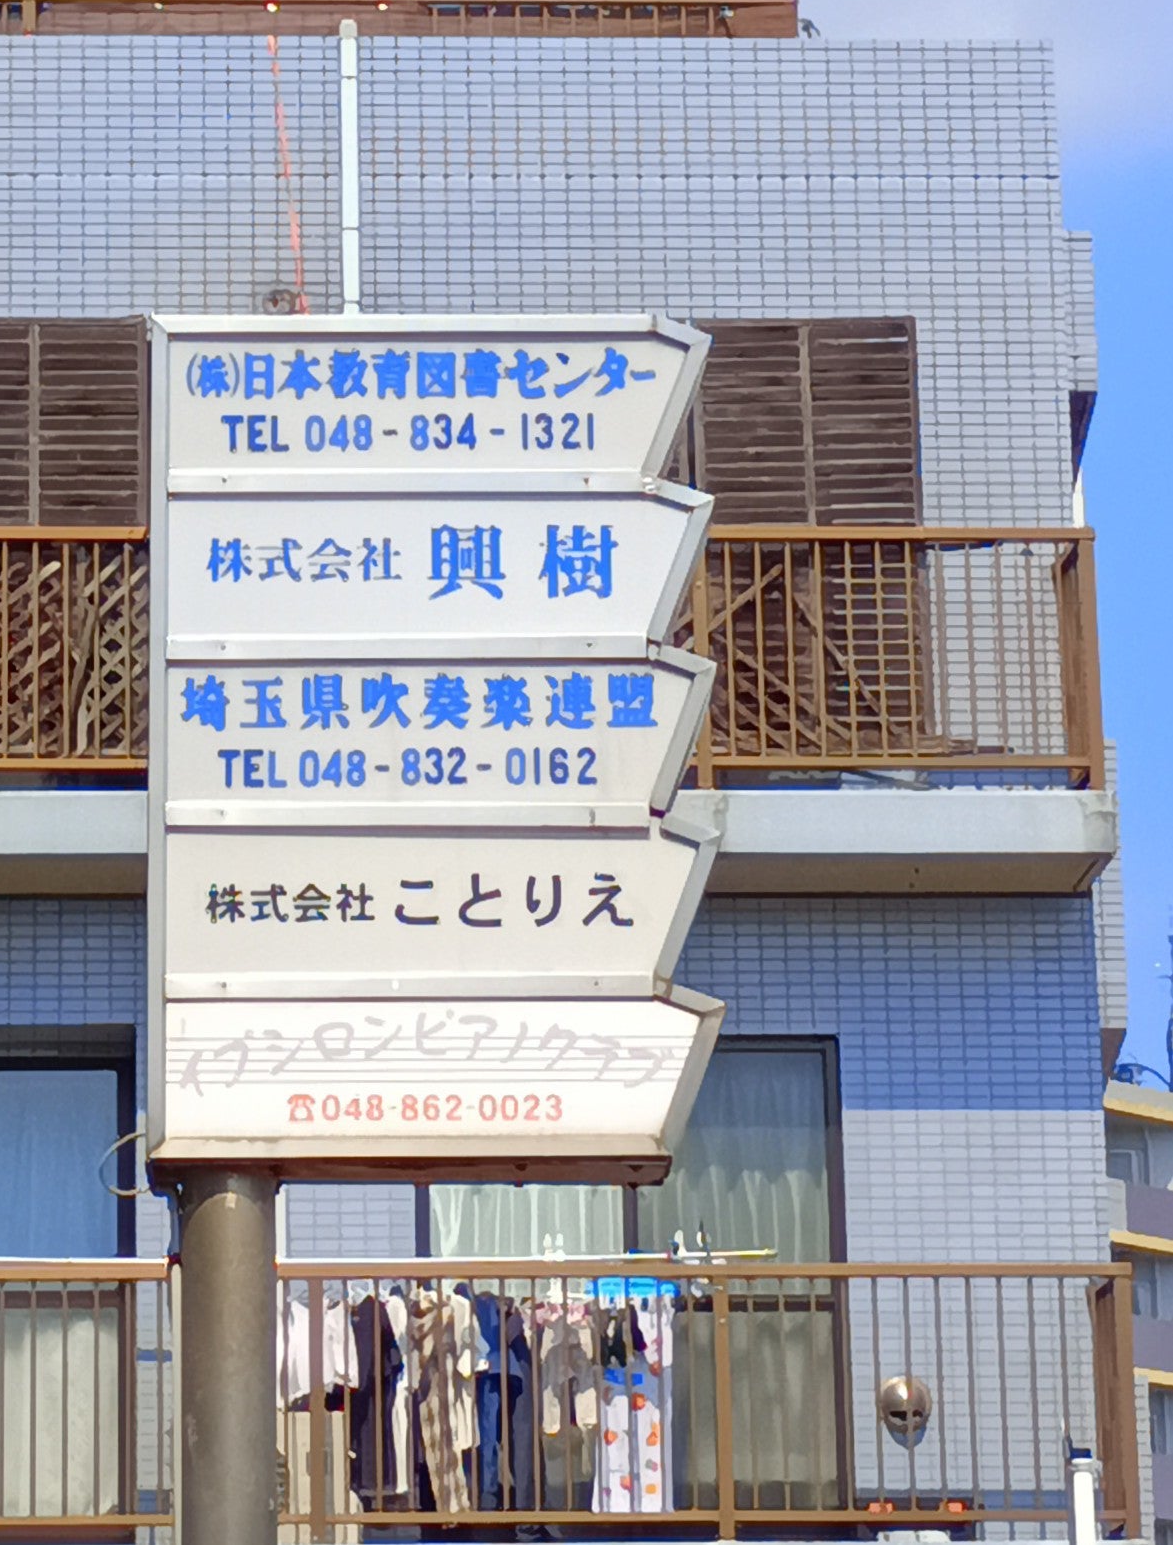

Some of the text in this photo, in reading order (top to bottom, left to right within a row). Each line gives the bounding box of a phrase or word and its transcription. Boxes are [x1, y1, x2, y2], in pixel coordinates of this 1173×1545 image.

[221, 415, 289, 453] TEL
[181, 672, 659, 731] 埼玉県吹奏楽連盟
[218, 749, 287, 788] TEL
